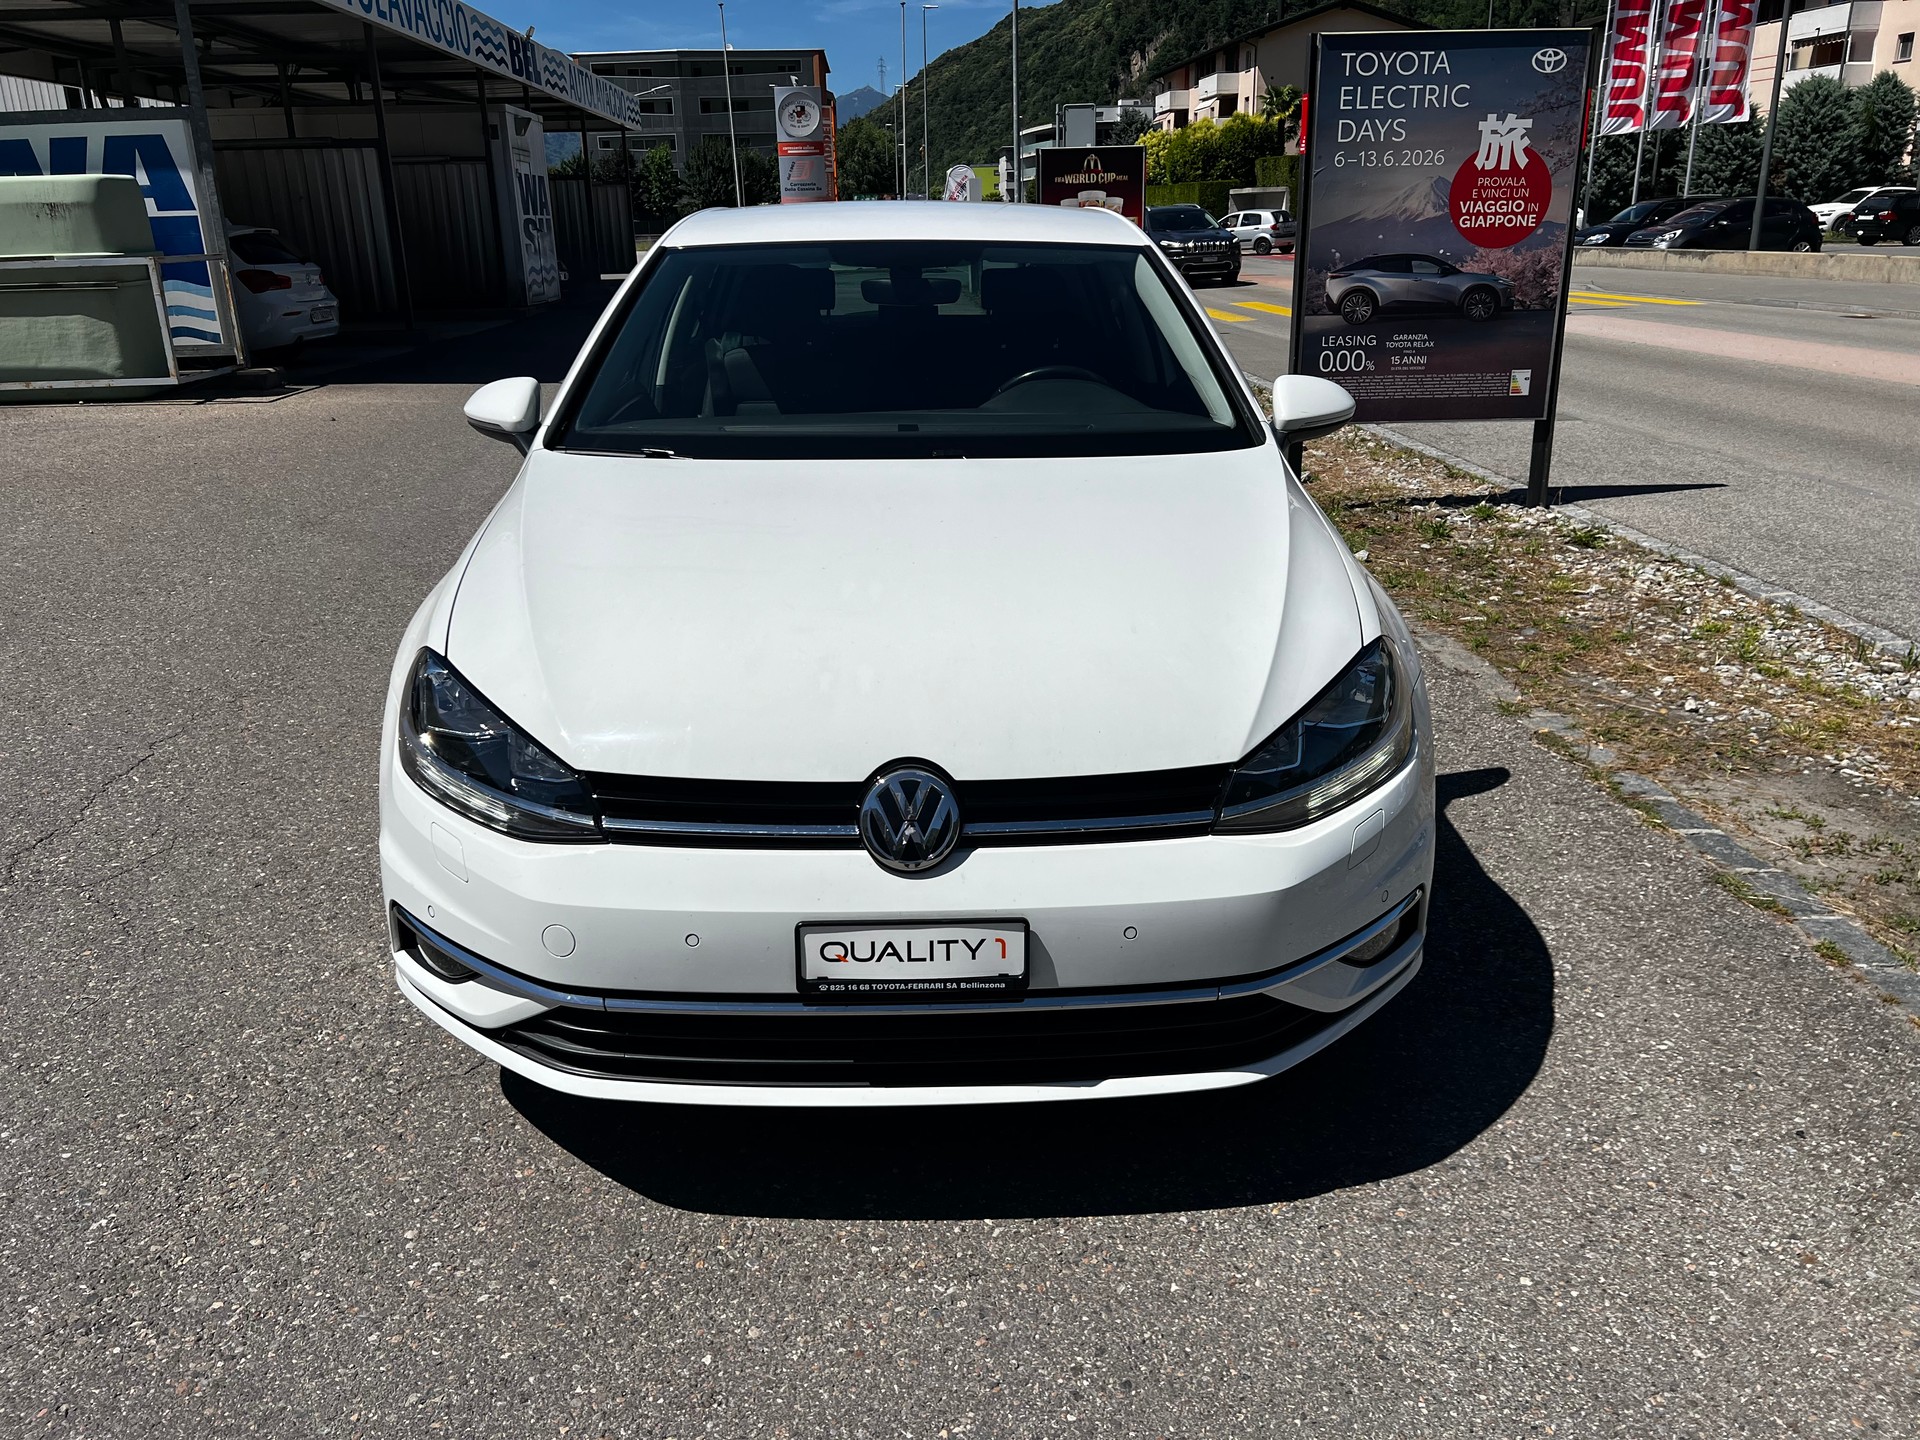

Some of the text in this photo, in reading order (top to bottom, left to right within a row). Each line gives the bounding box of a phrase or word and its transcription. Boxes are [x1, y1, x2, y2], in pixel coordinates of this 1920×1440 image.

[507, 30, 542, 86] BEL
[1341, 51, 1451, 77] TOYOTA
[1608, 0, 1651, 127] JUM
[1339, 84, 1471, 110] ELECTRIC
[1337, 118, 1407, 143] DAYS
[1474, 113, 1533, 171] 旅
[1065, 172, 1097, 184] WORLD
[1098, 172, 1116, 184] CUP
[1477, 177, 1527, 187] PROVALA
[518, 172, 551, 216] WA
[1472, 188, 1530, 198] E VINCI UN
[1459, 200, 1539, 214] VIAGGIO IN
[1459, 214, 1537, 228] GIAPPONE
[1321, 335, 1377, 347] LEASING
[1390, 355, 1427, 365] 15 ANNI
[819, 938, 987, 963] QUALITY
[946, 982, 958, 990] SA
[960, 981, 1006, 989] Bellinzona
